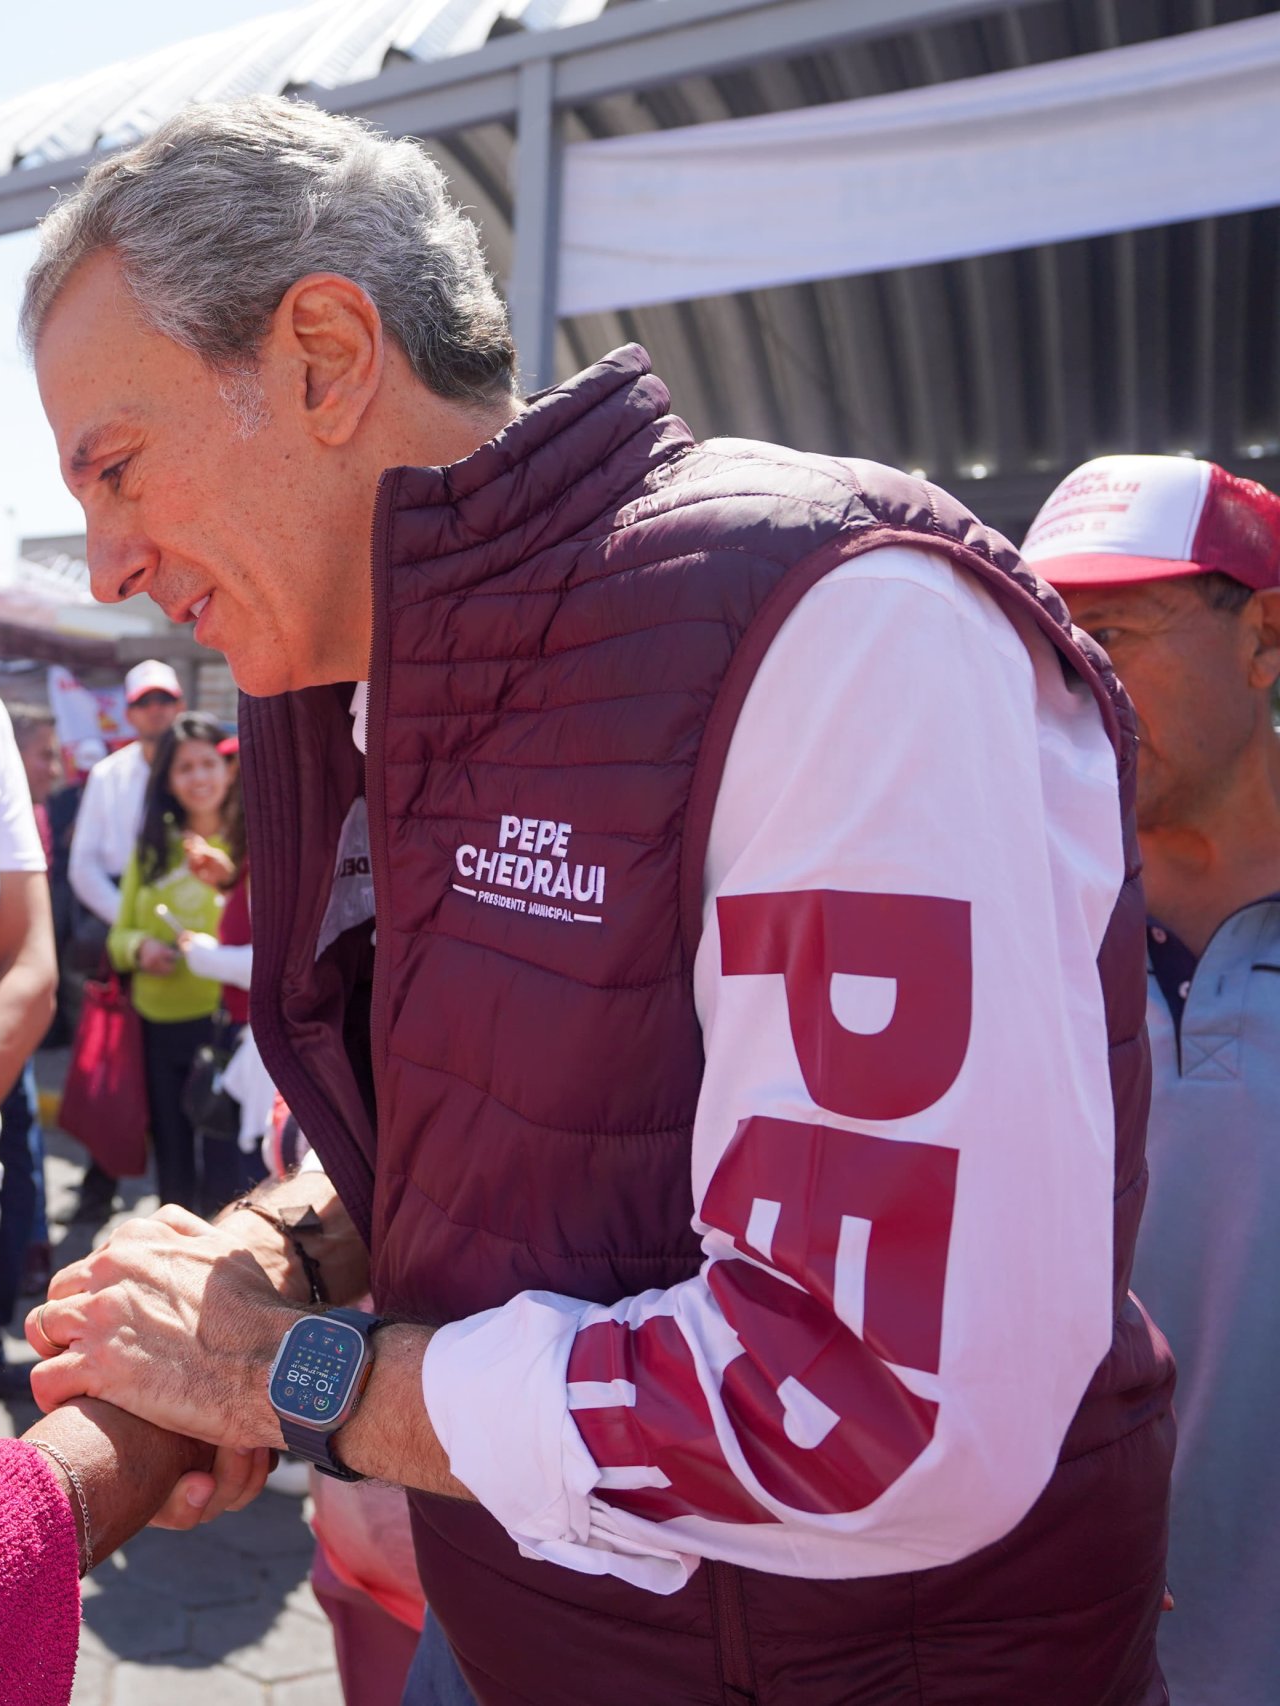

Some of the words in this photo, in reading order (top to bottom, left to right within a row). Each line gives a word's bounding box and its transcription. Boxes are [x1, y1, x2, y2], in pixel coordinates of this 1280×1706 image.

[499, 815, 572, 858] PEPE
[455, 844, 605, 904] CHEDRAUI
[477, 890, 526, 913] PRESIDENTE
[528, 901, 574, 922] MUNICIPAL
[566, 889, 974, 1525] PEPE
[286, 1370, 335, 1395] 10:38
